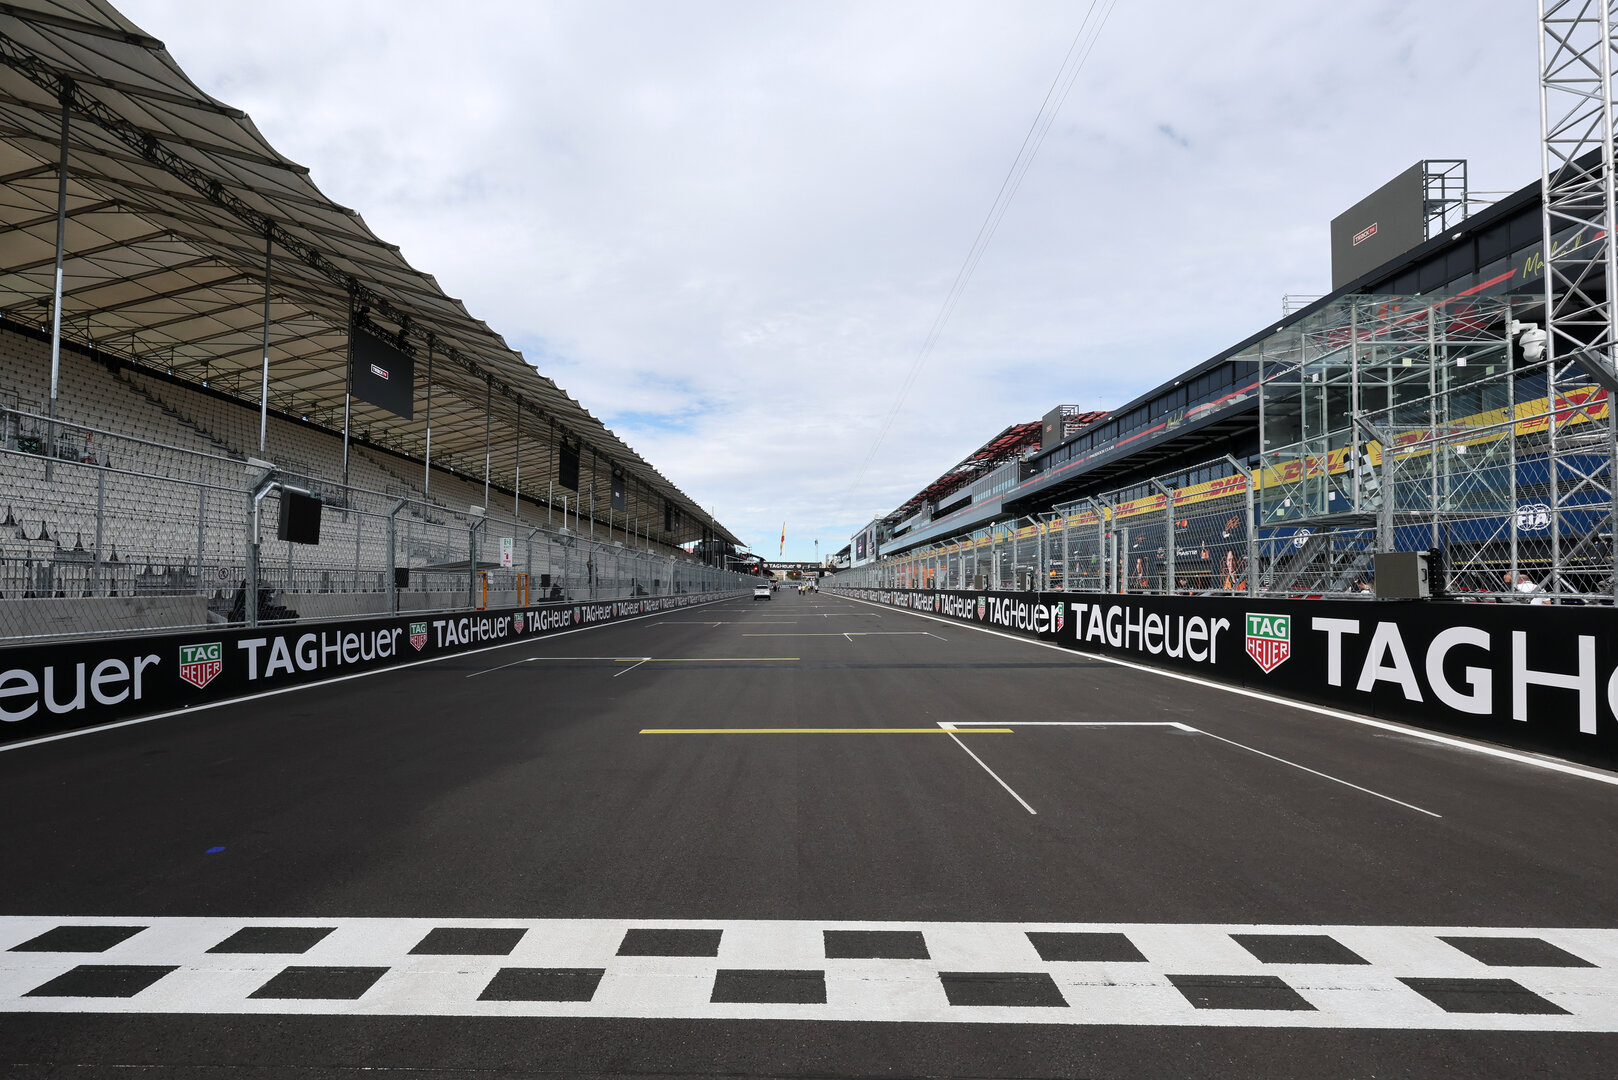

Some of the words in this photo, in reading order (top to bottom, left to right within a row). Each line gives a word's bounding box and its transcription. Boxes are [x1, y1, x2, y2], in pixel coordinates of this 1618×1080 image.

[1284, 453, 1338, 480] DHL
[1210, 475, 1247, 497] DHL
[1517, 508, 1549, 527] FIA
[581, 605, 611, 623] TAGHeuer
[941, 594, 976, 619] TAGHeuer
[988, 597, 1061, 633] TAGHeuer
[411, 624, 426, 634] TAG
[433, 616, 511, 648] TAGHeuer
[526, 609, 572, 633] TAGHeuer
[1071, 602, 1230, 664] TAGHeuer
[1249, 616, 1286, 637] TAG
[183, 645, 219, 662] TAG
[238, 626, 402, 680] TAGHeuer
[1248, 639, 1288, 668] HEUER
[182, 662, 220, 685] HEUER
[1312, 617, 1618, 735] TAGH
[0, 654, 161, 722] euer
